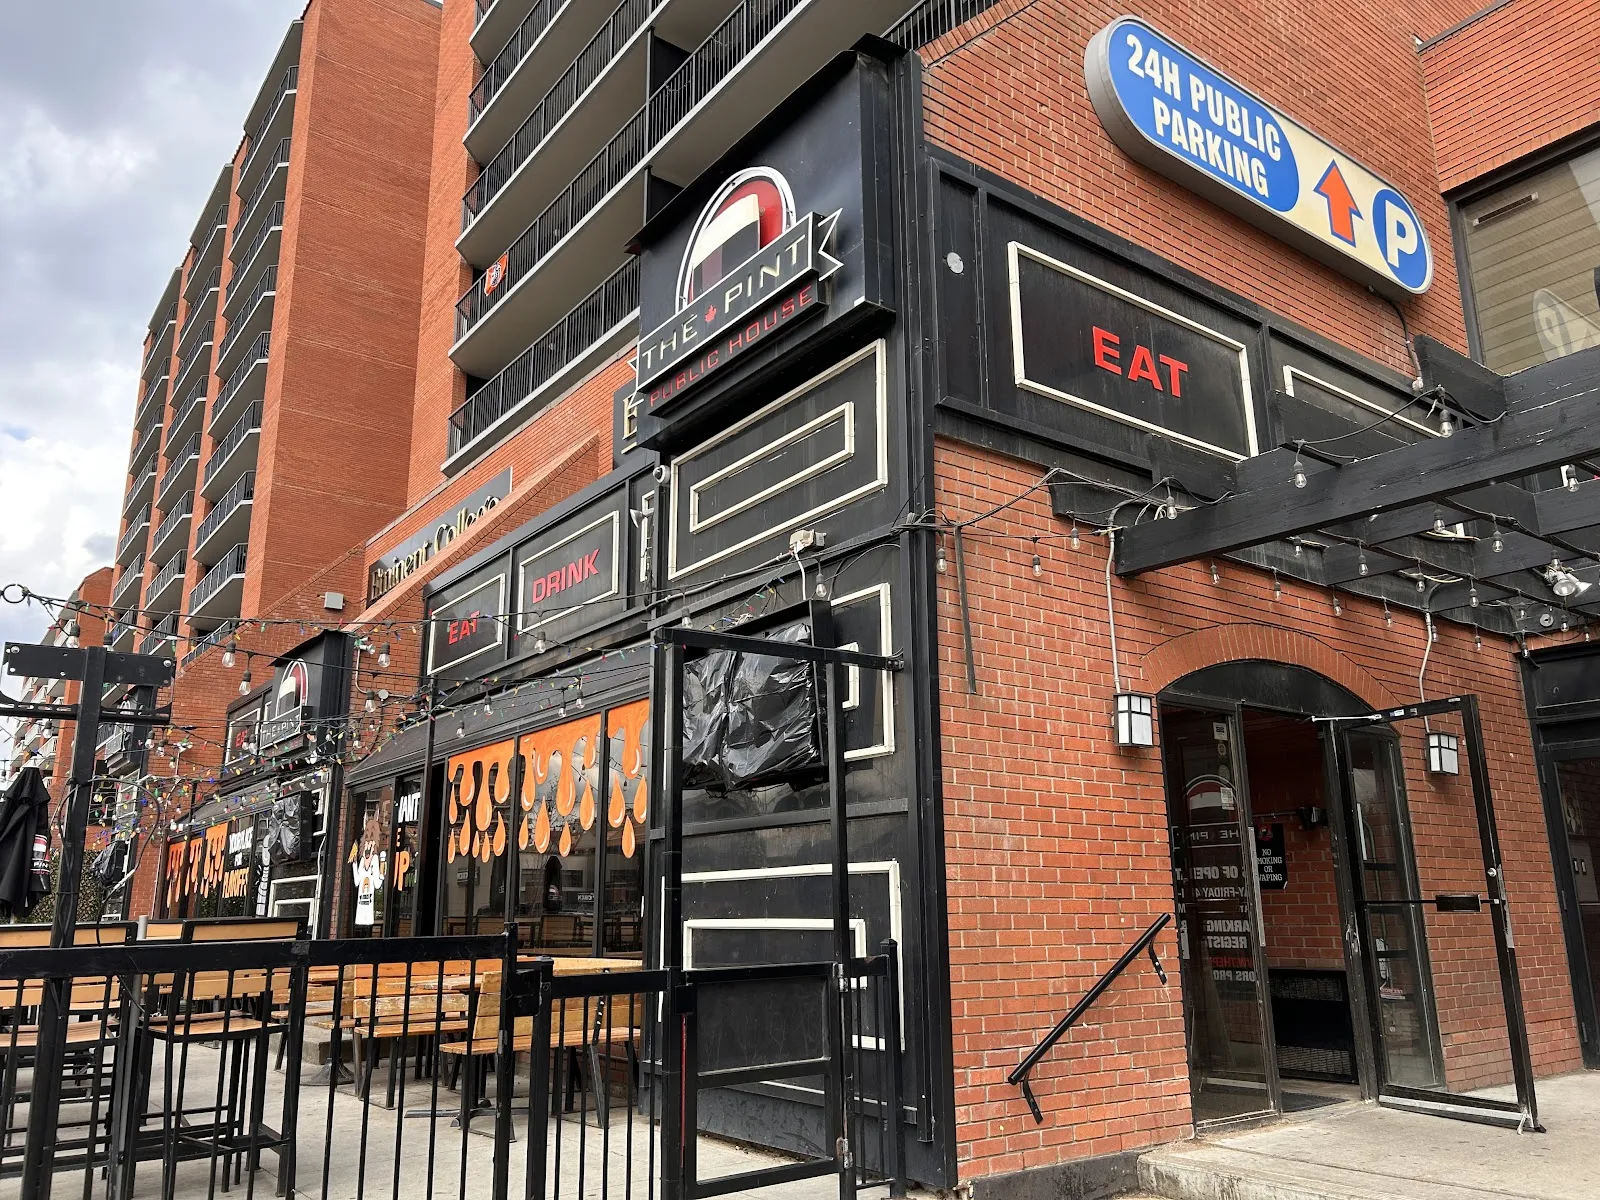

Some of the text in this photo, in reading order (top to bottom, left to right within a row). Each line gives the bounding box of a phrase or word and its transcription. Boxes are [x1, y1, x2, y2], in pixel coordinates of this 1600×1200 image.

[1126, 33, 1281, 162] 24H PUBLIC
[1152, 96, 1269, 198] PARKING
[1385, 200, 1418, 268] P
[642, 234, 806, 370] THE PINT
[650, 285, 813, 408] PUBLIC HOUSE
[1092, 326, 1189, 398] EAT
[371, 541, 432, 600] Eminent
[532, 548, 601, 604] DRINK
[449, 610, 481, 645] EAT
[261, 724, 276, 742] THE
[221, 867, 250, 899] PLAYOFFS
[1257, 857, 1283, 865] MOKING
